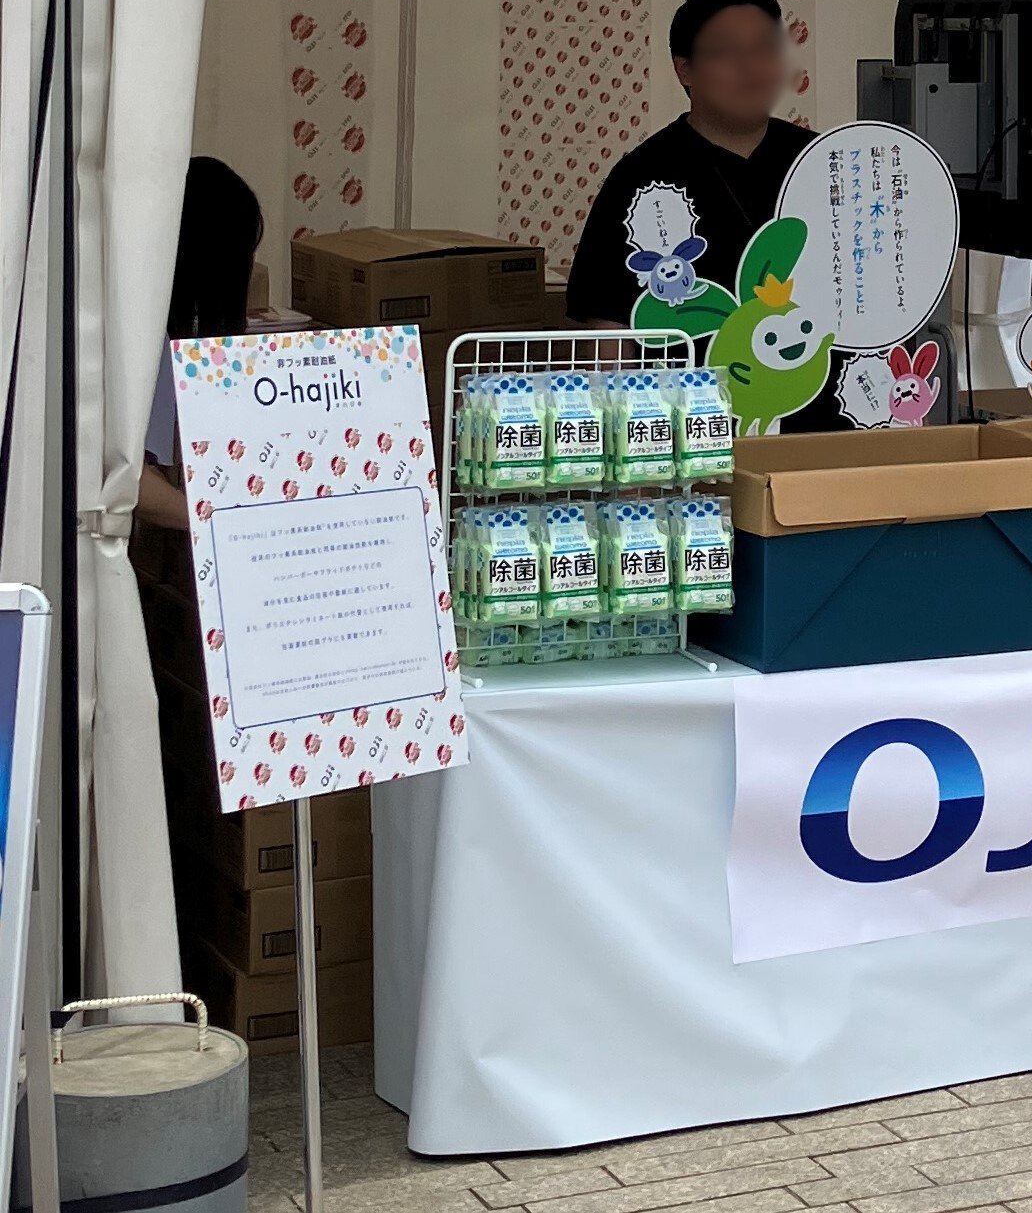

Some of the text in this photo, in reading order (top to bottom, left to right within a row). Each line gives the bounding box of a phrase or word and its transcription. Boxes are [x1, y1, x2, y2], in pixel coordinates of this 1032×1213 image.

[850, 149, 865, 315] プラスチックを作ることに
[254, 368, 361, 412] O-hajiki
[495, 423, 542, 448] 除菌
[554, 419, 600, 444] 除菌
[627, 418, 671, 443] 除菌
[685, 415, 729, 440] 除菌
[489, 557, 537, 583] 除菌
[550, 552, 596, 579] 除菌
[620, 550, 665, 575] 除菌
[685, 547, 729, 571] 除菌
